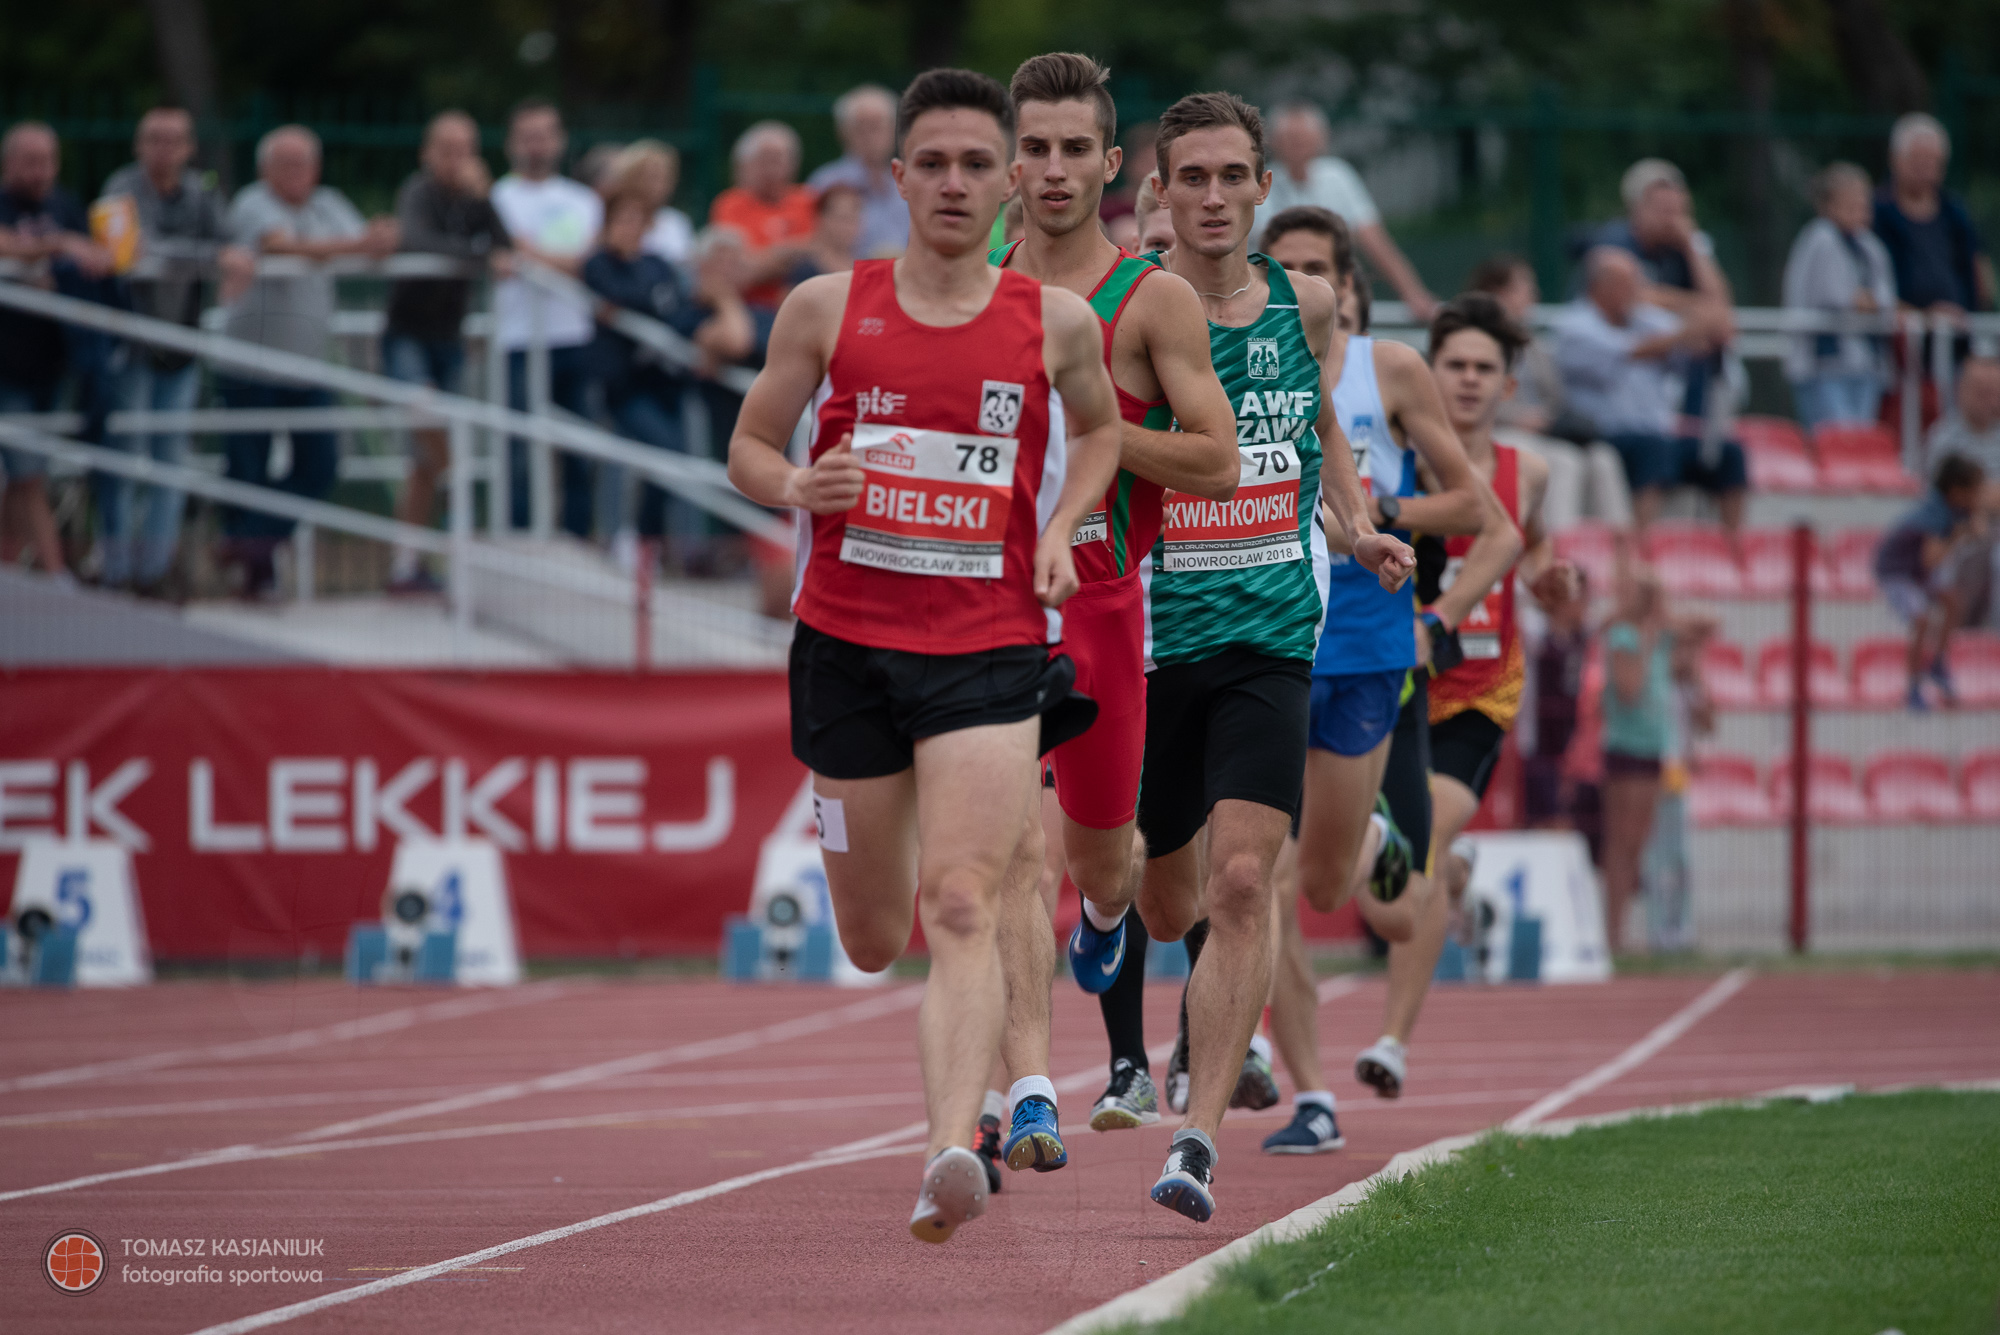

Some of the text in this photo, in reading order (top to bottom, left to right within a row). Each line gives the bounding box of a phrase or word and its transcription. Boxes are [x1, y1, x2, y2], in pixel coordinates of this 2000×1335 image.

[1251, 363, 1263, 376] AZS
[1239, 390, 1314, 417] AWF
[867, 451, 914, 470] ORLEN
[955, 444, 1000, 474] 78
[1252, 450, 1289, 476] 70
[866, 483, 990, 529] BIELSKI
[1168, 492, 1294, 529] KWIATKOWSKI
[1072, 529, 1098, 543] 018
[1185, 542, 1230, 550] DRUŻYNOWE
[1231, 537, 1276, 549] MISTRZOSTWA
[1276, 533, 1298, 541] POLSKI
[850, 545, 991, 575] INOWROCŁAW 2018
[1173, 547, 1294, 569] INOWROCŁAW 2018
[188, 757, 735, 853] LEKKIEJ
[56, 868, 93, 930] 5
